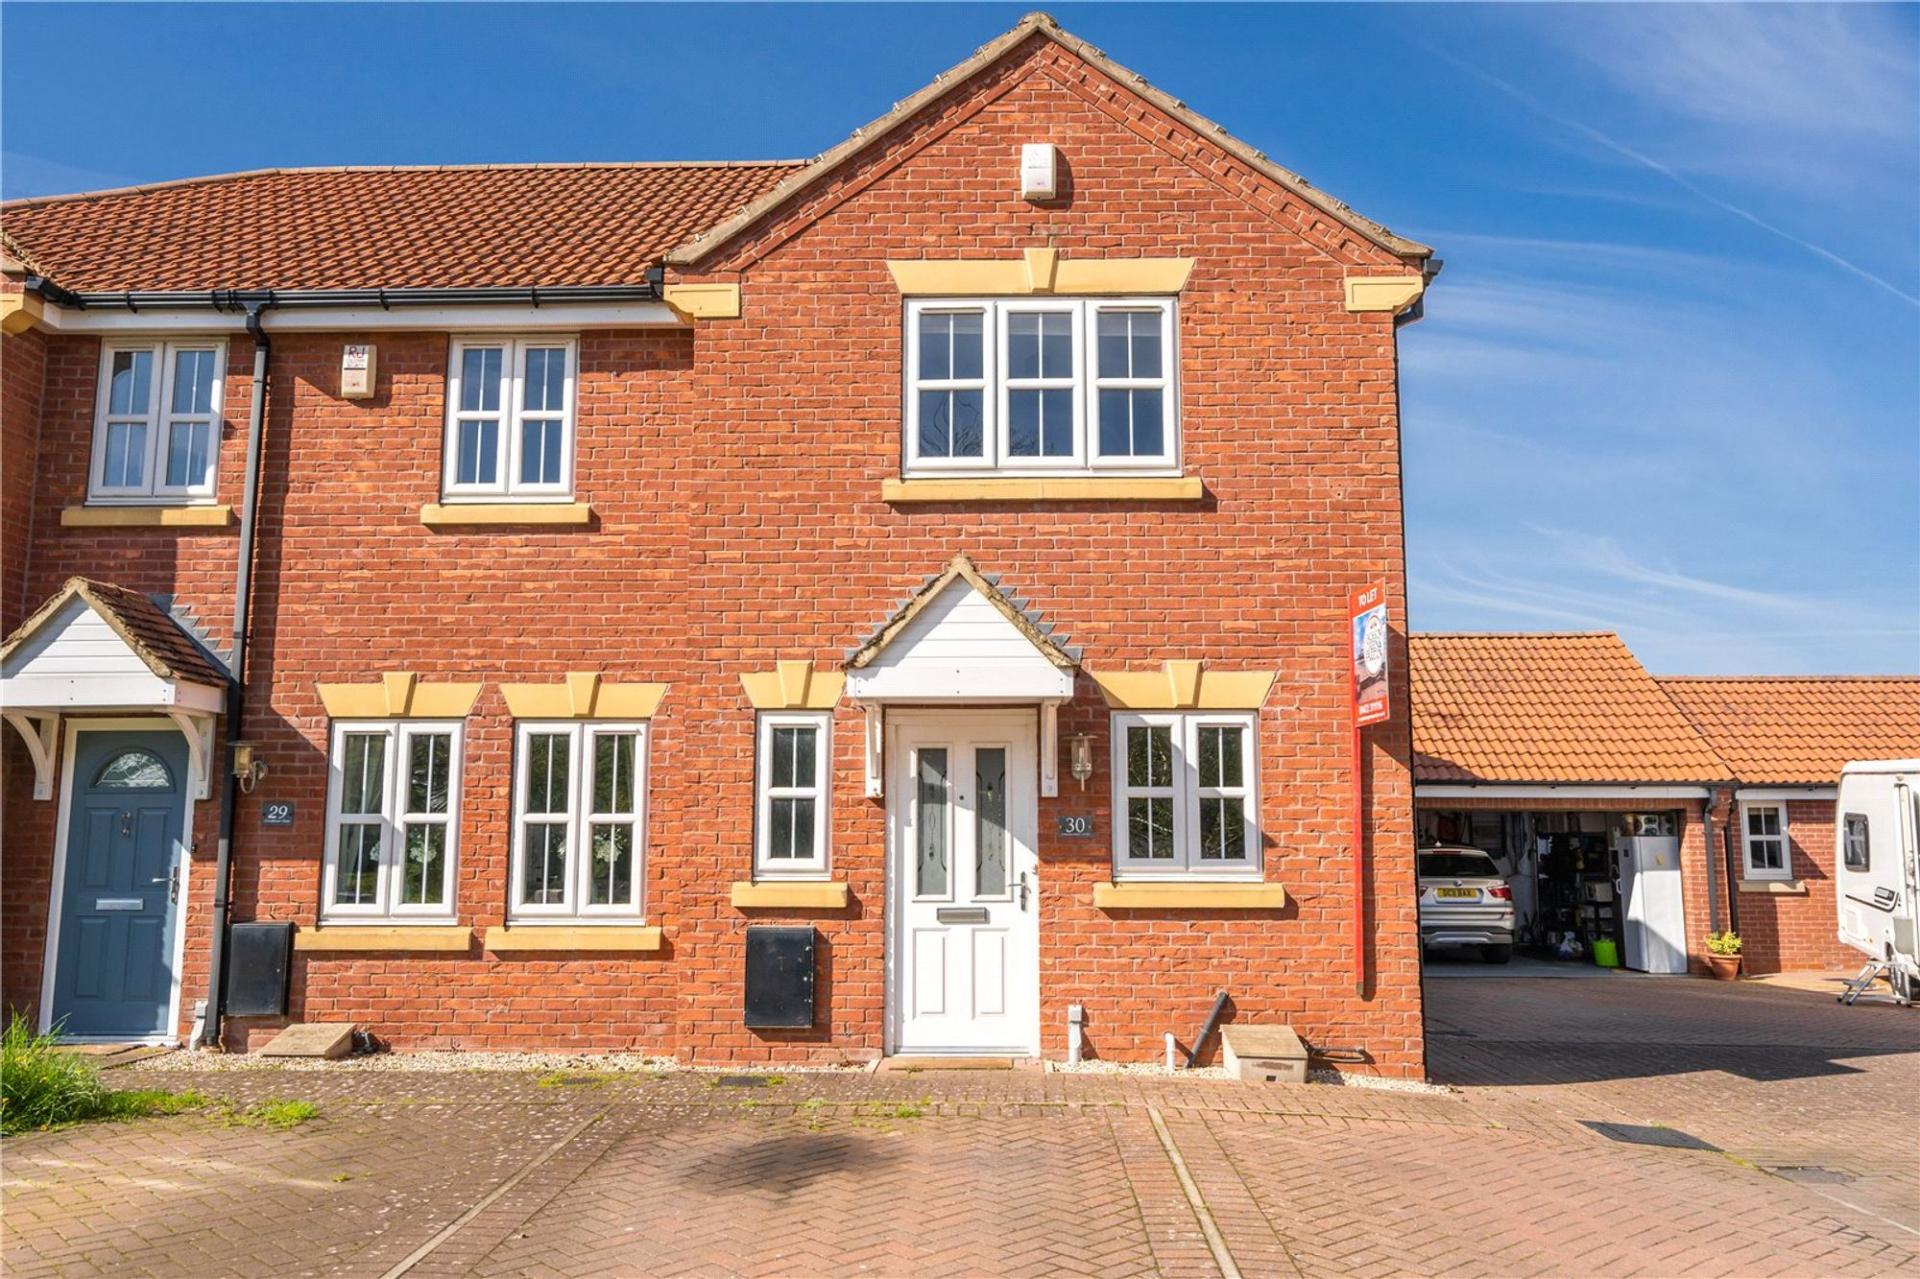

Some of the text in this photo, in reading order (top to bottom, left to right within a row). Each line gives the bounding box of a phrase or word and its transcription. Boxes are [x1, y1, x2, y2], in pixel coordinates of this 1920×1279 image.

[1358, 587, 1377, 607] TO LET
[267, 804, 288, 819] 29
[1065, 816, 1085, 833] 30
